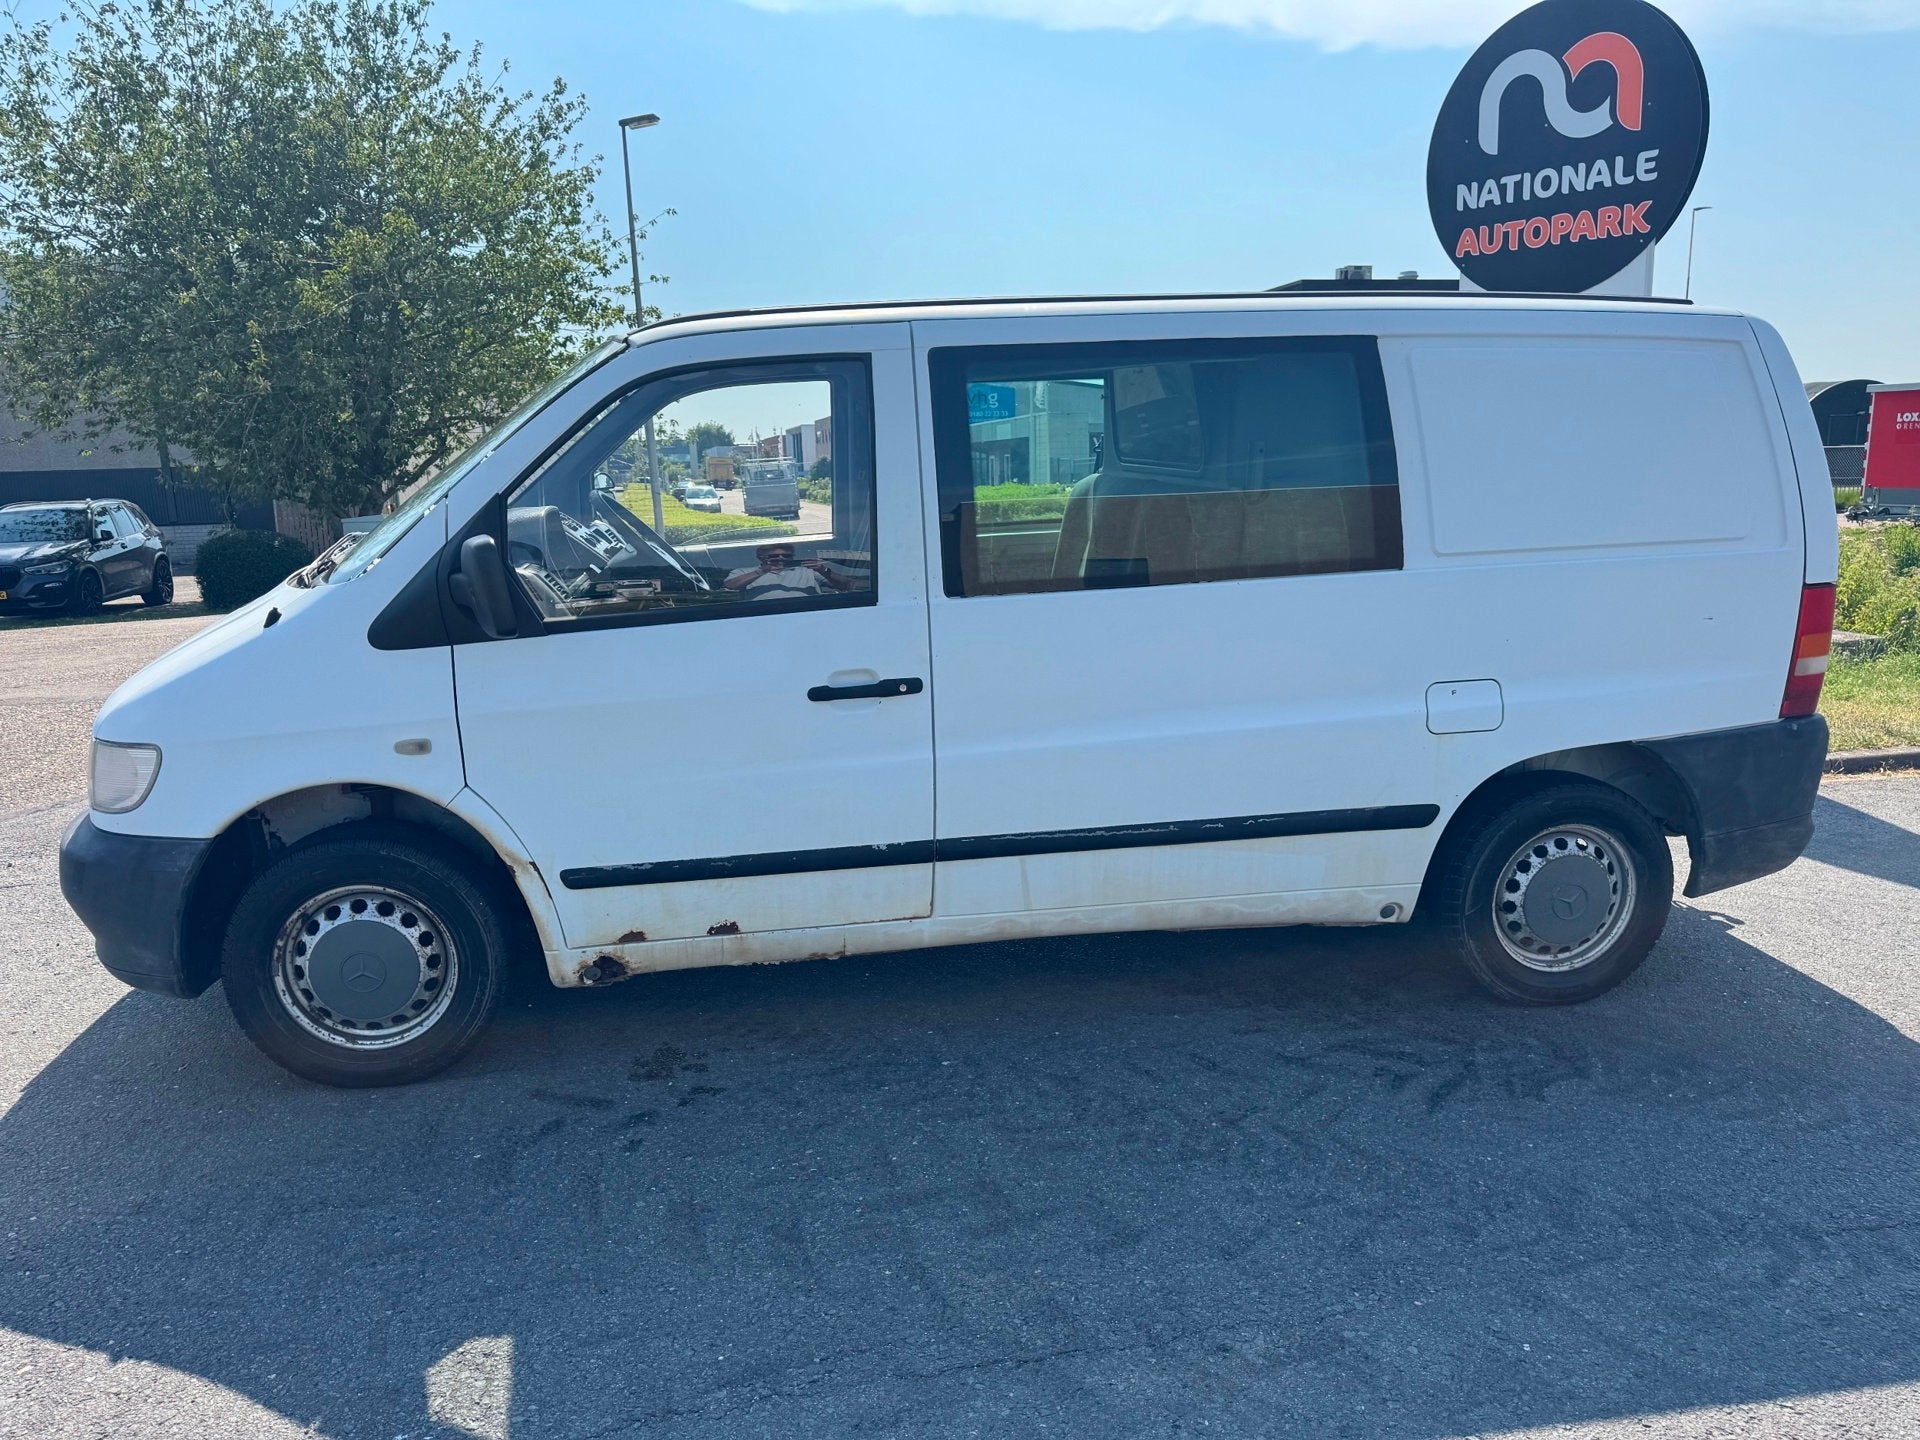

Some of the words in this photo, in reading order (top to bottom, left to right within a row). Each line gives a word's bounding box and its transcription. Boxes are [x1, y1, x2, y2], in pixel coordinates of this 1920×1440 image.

[1456, 149, 1659, 212] NATIONALE
[1455, 200, 1652, 258] AUTOPARK
[1896, 412, 1920, 422] LOX
